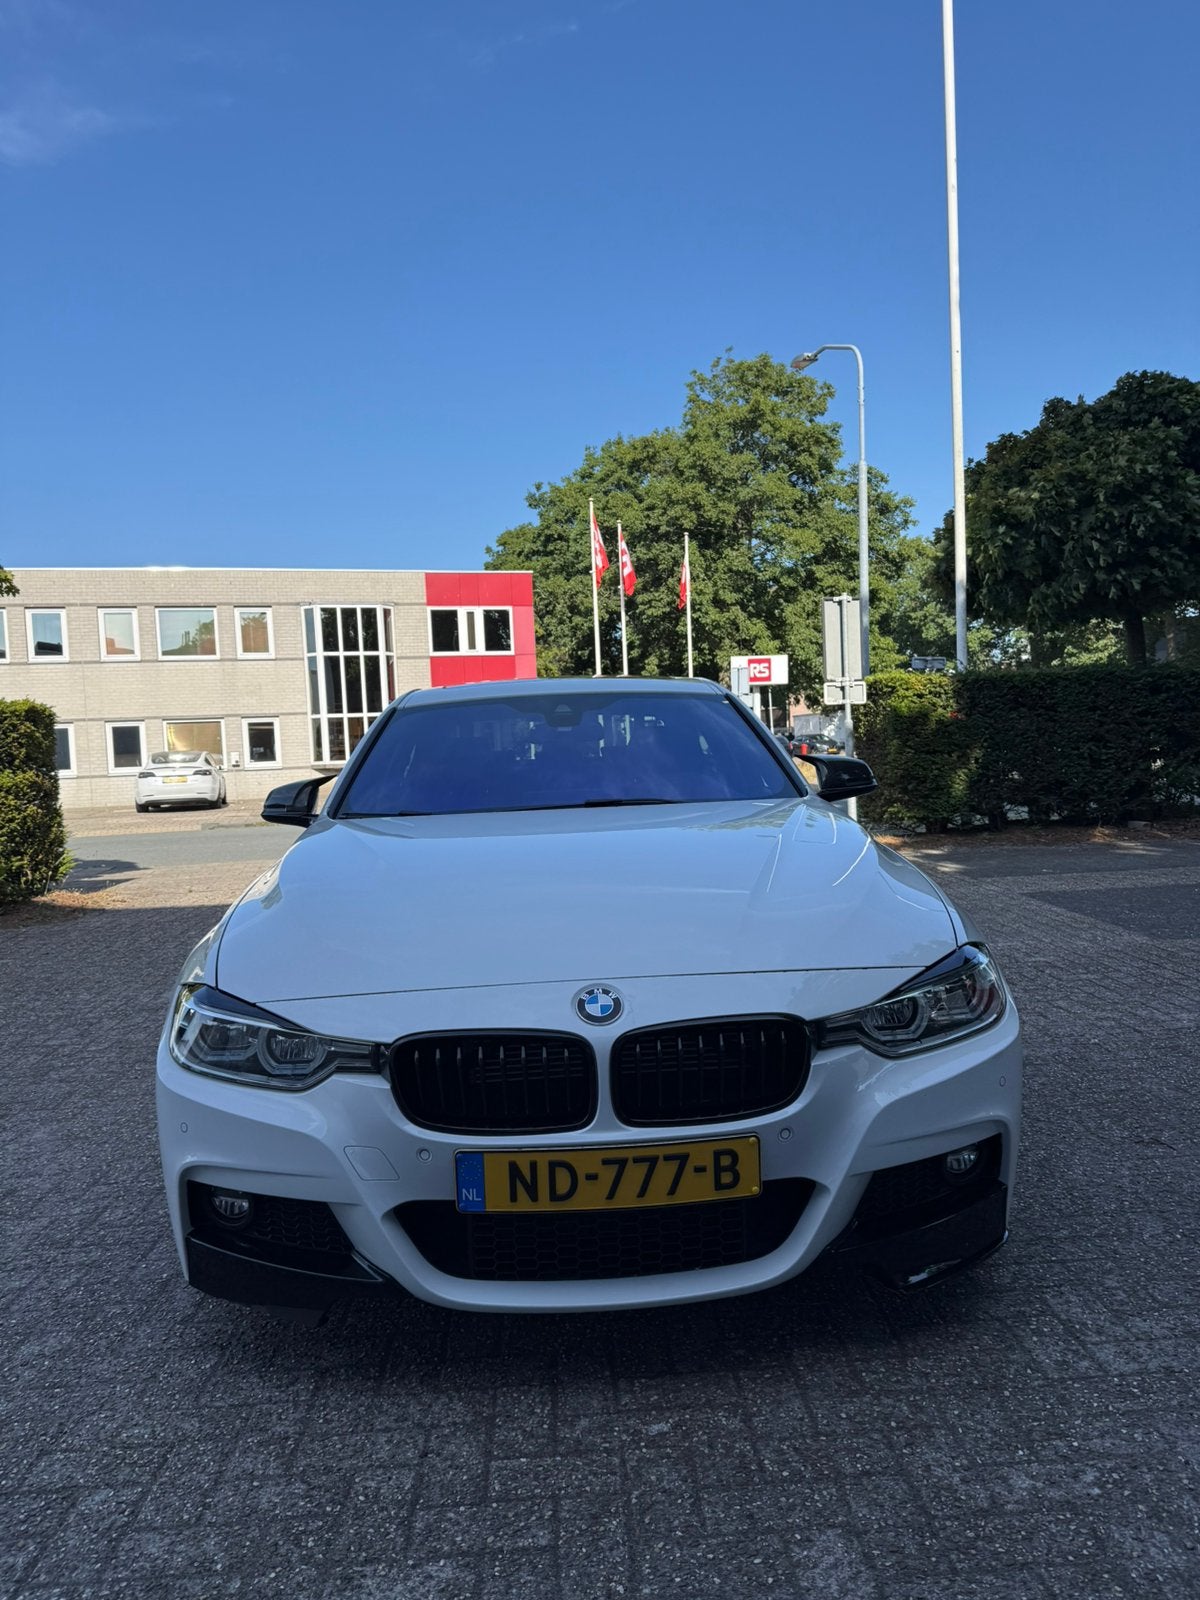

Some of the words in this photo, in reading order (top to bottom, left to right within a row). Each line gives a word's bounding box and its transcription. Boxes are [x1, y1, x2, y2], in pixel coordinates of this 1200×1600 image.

[749, 662, 770, 679] RS
[508, 1148, 741, 1202] ND-777-B
[462, 1188, 482, 1201] NL
